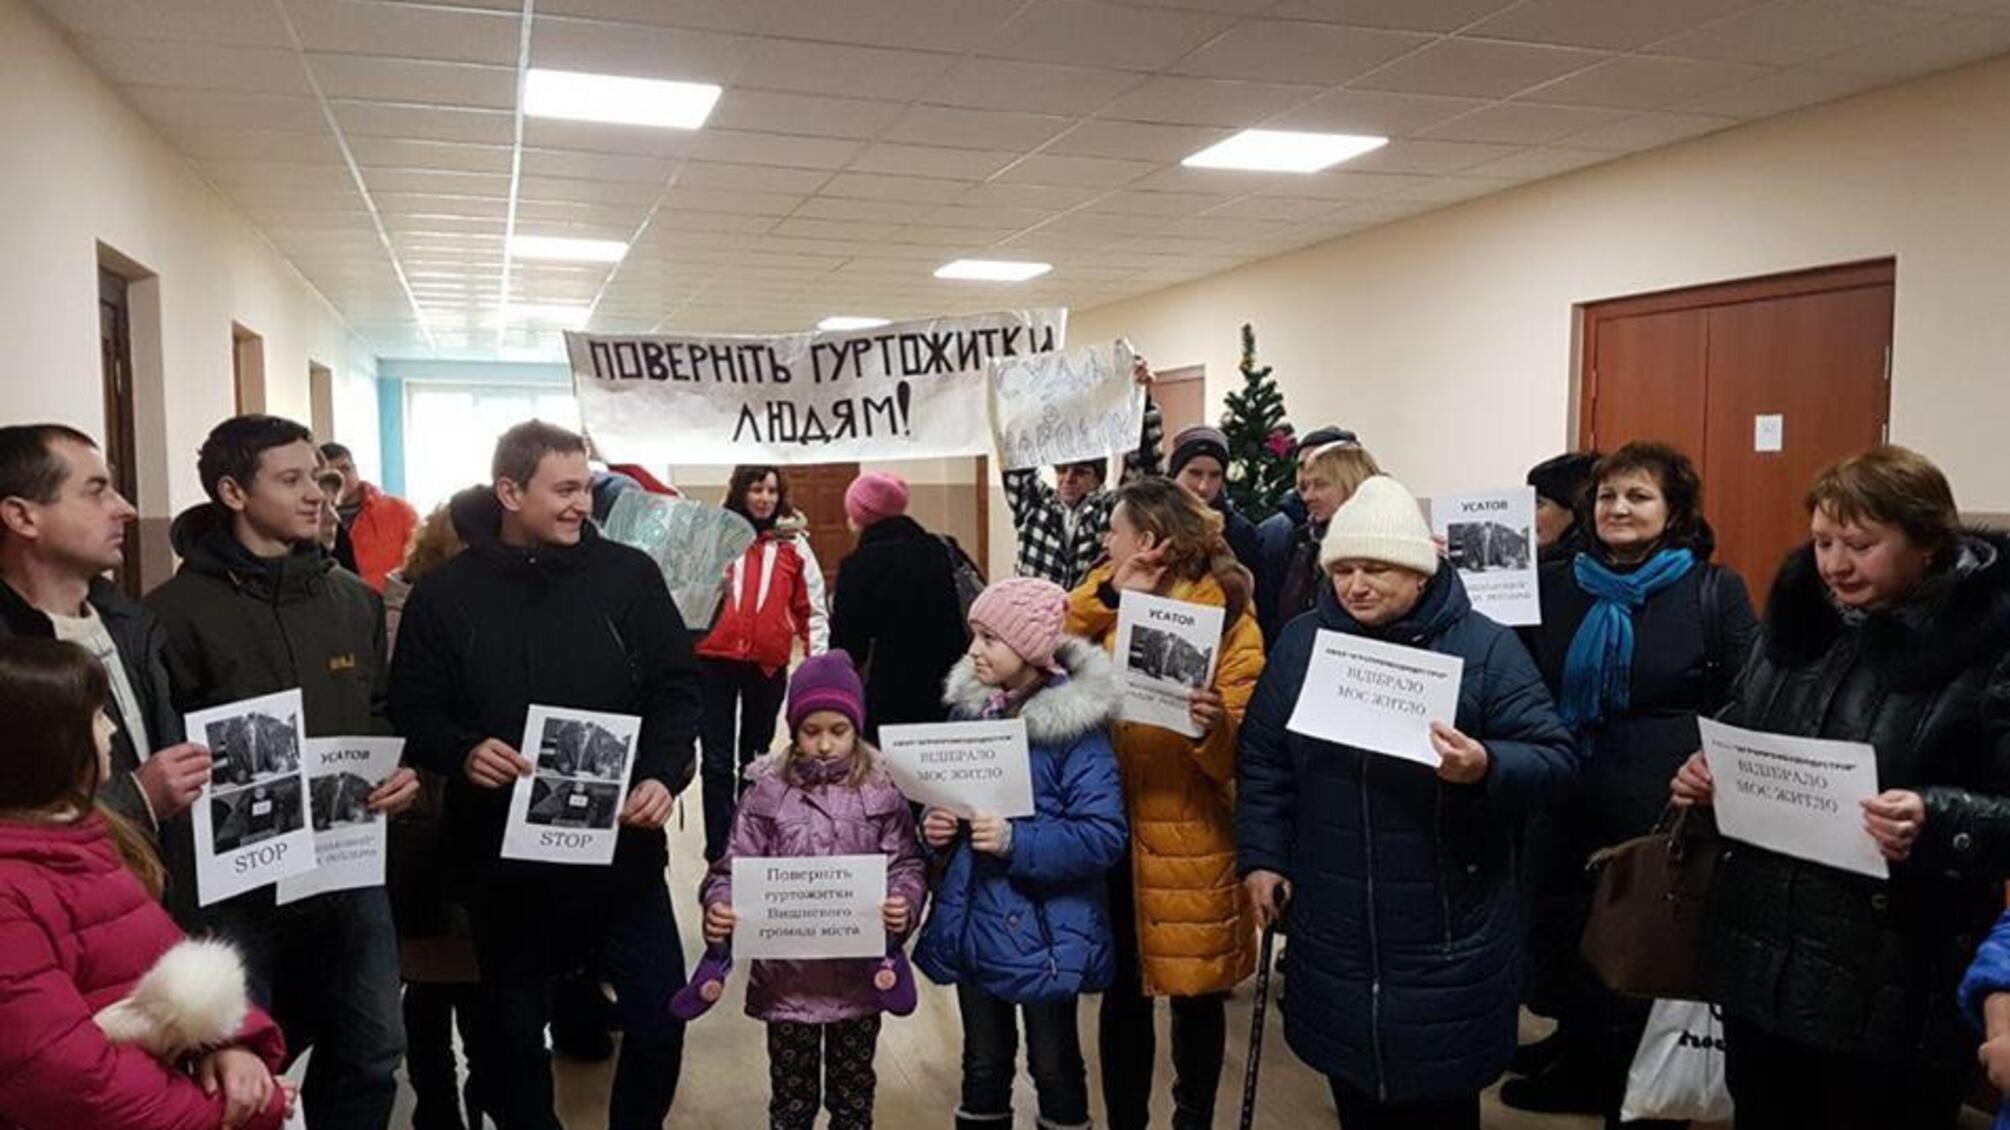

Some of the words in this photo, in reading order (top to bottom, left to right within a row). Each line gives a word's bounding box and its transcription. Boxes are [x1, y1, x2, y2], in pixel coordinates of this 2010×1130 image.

[588, 341, 791, 383] ПОВЕРНІТЬ
[810, 325, 1054, 384] ГУРТОЖИТКИ
[733, 380, 910, 444] ЛЮДЯМ!
[1461, 500, 1508, 512] УСАТОВ
[1149, 609, 1195, 626] УСАТОВ
[320, 749, 370, 764] УСАТОВ
[540, 832, 593, 849] STOP
[235, 842, 288, 873] STOP
[766, 868, 853, 883] Поверніть
[765, 889, 853, 902] гуртожитки
